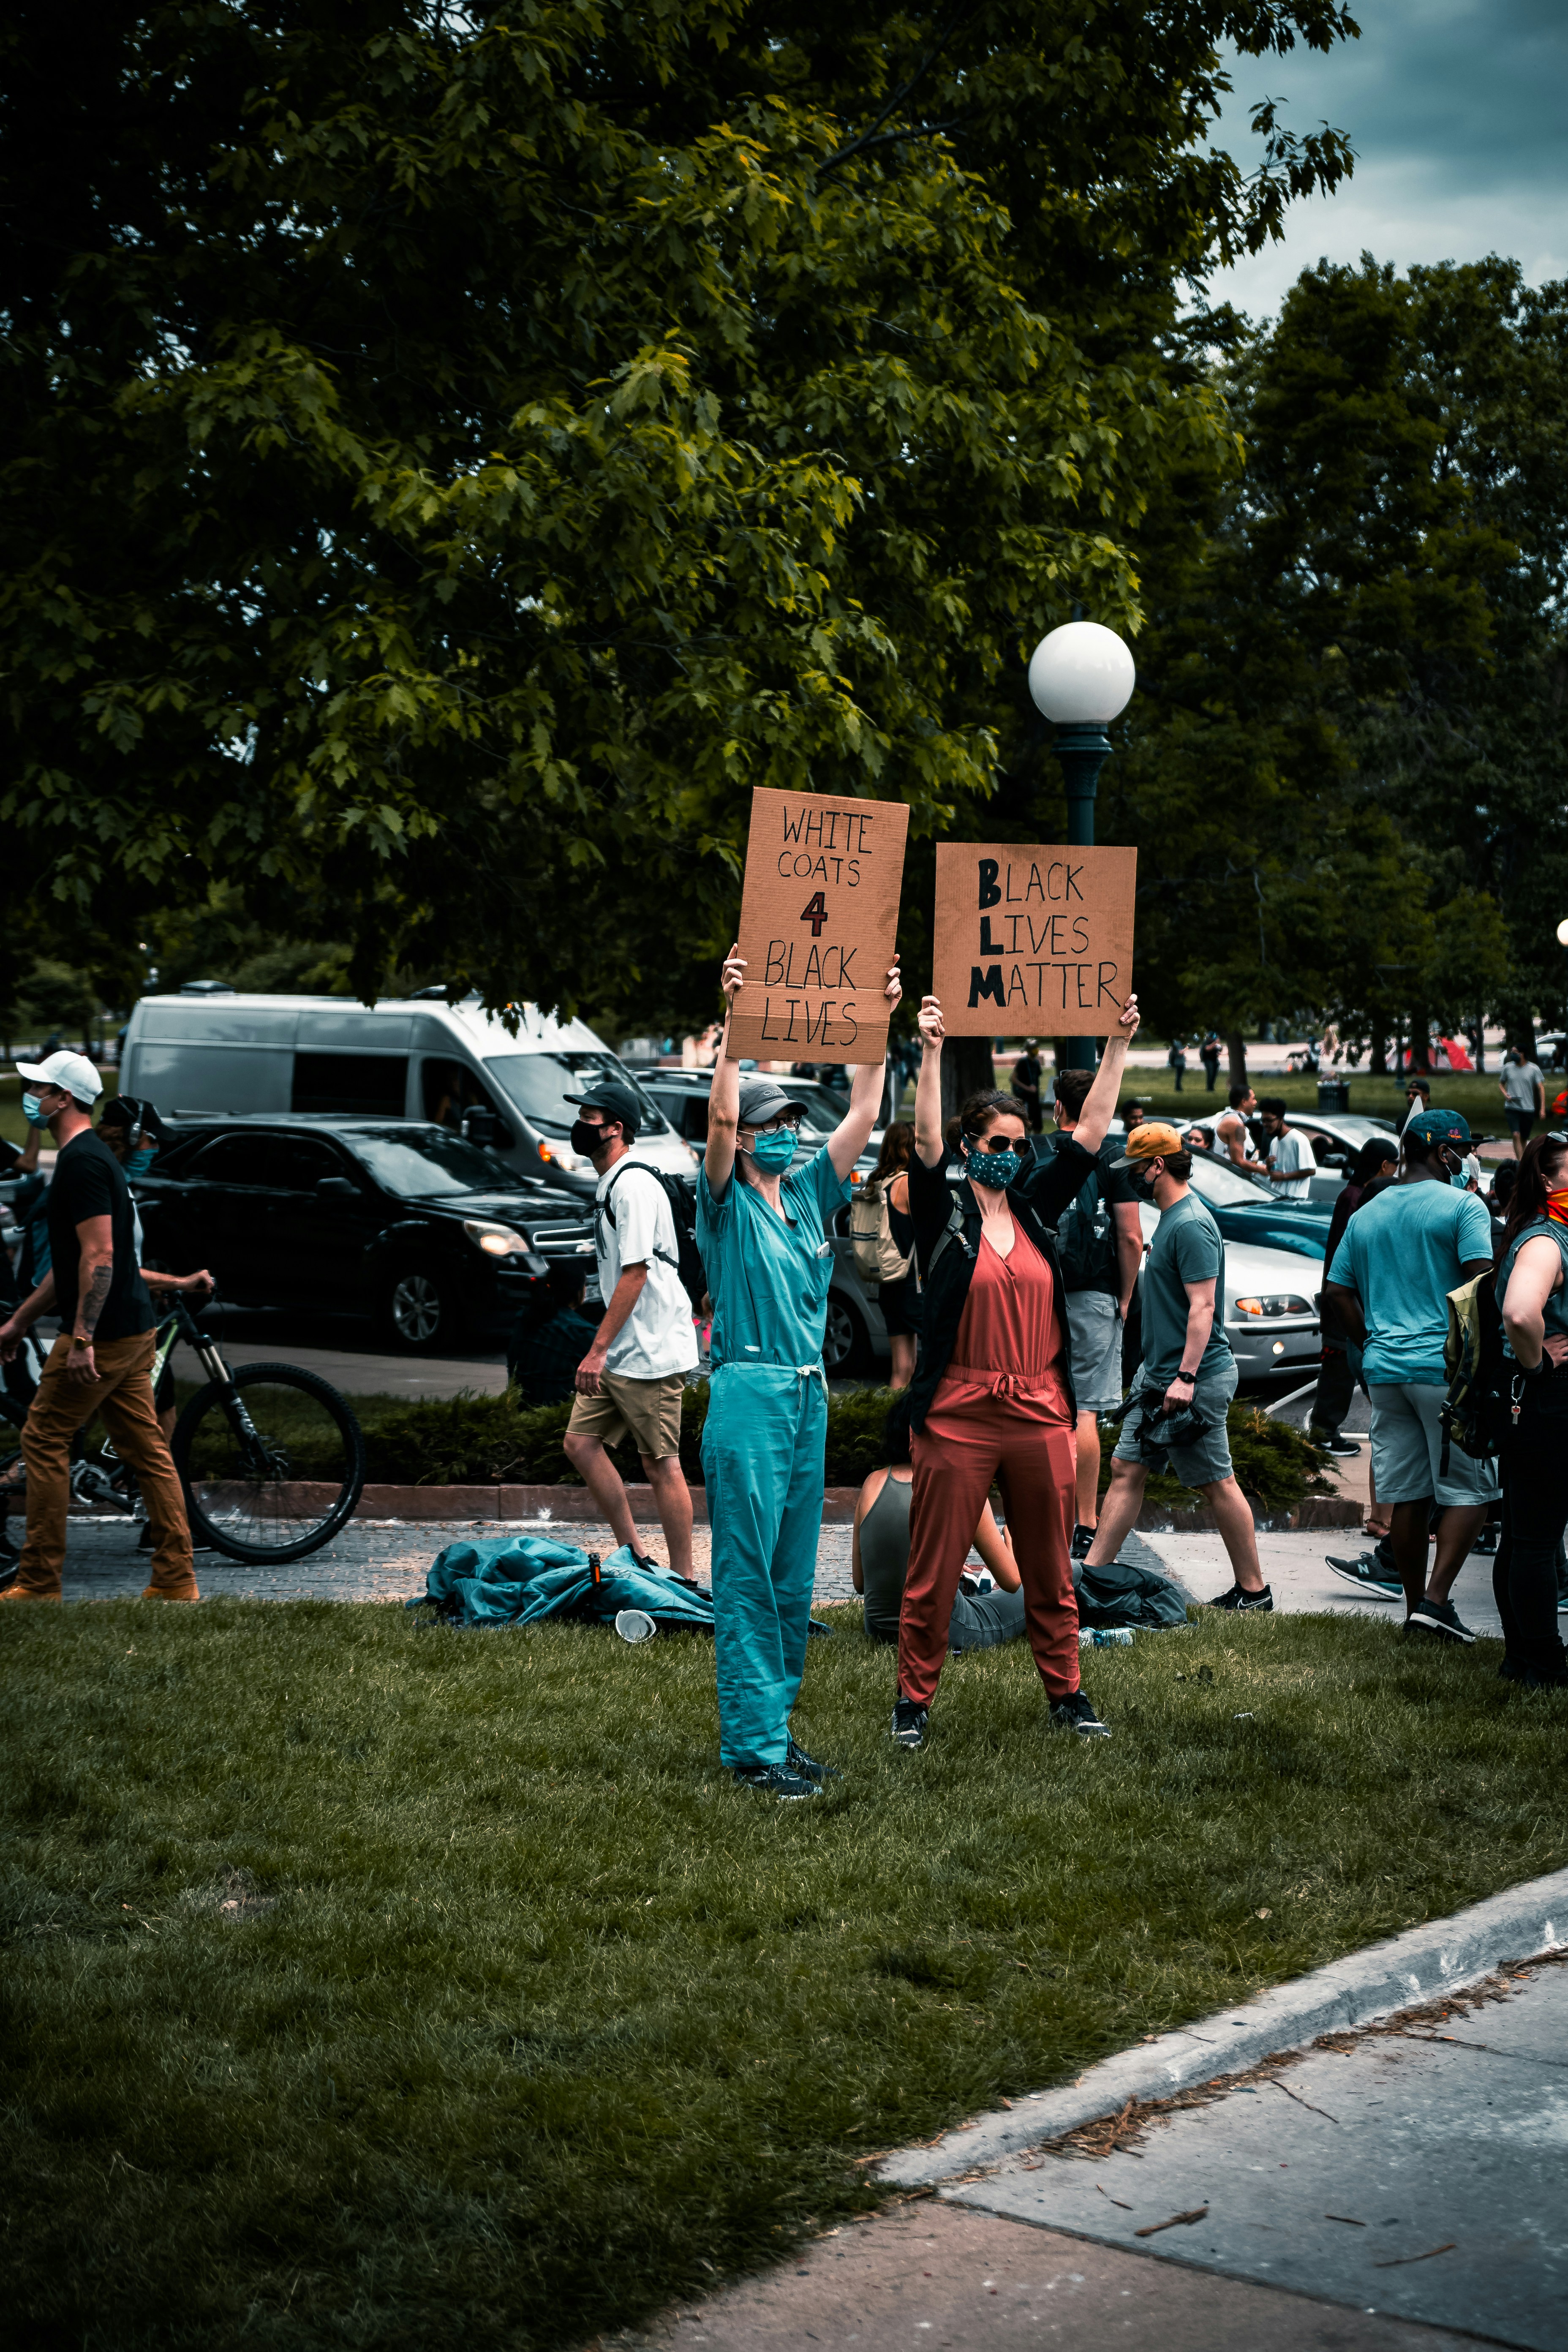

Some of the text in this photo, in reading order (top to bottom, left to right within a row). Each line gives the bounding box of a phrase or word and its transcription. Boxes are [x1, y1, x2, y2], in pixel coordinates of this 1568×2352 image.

[783, 806, 874, 854] WHITE
[778, 851, 860, 887] COATS
[978, 858, 1084, 910] BLACK
[800, 891, 828, 937] 4
[980, 915, 1089, 956] LIVES
[764, 939, 857, 991] BLACK
[967, 961, 1121, 1009] MATTER
[761, 997, 858, 1046] LIVES
